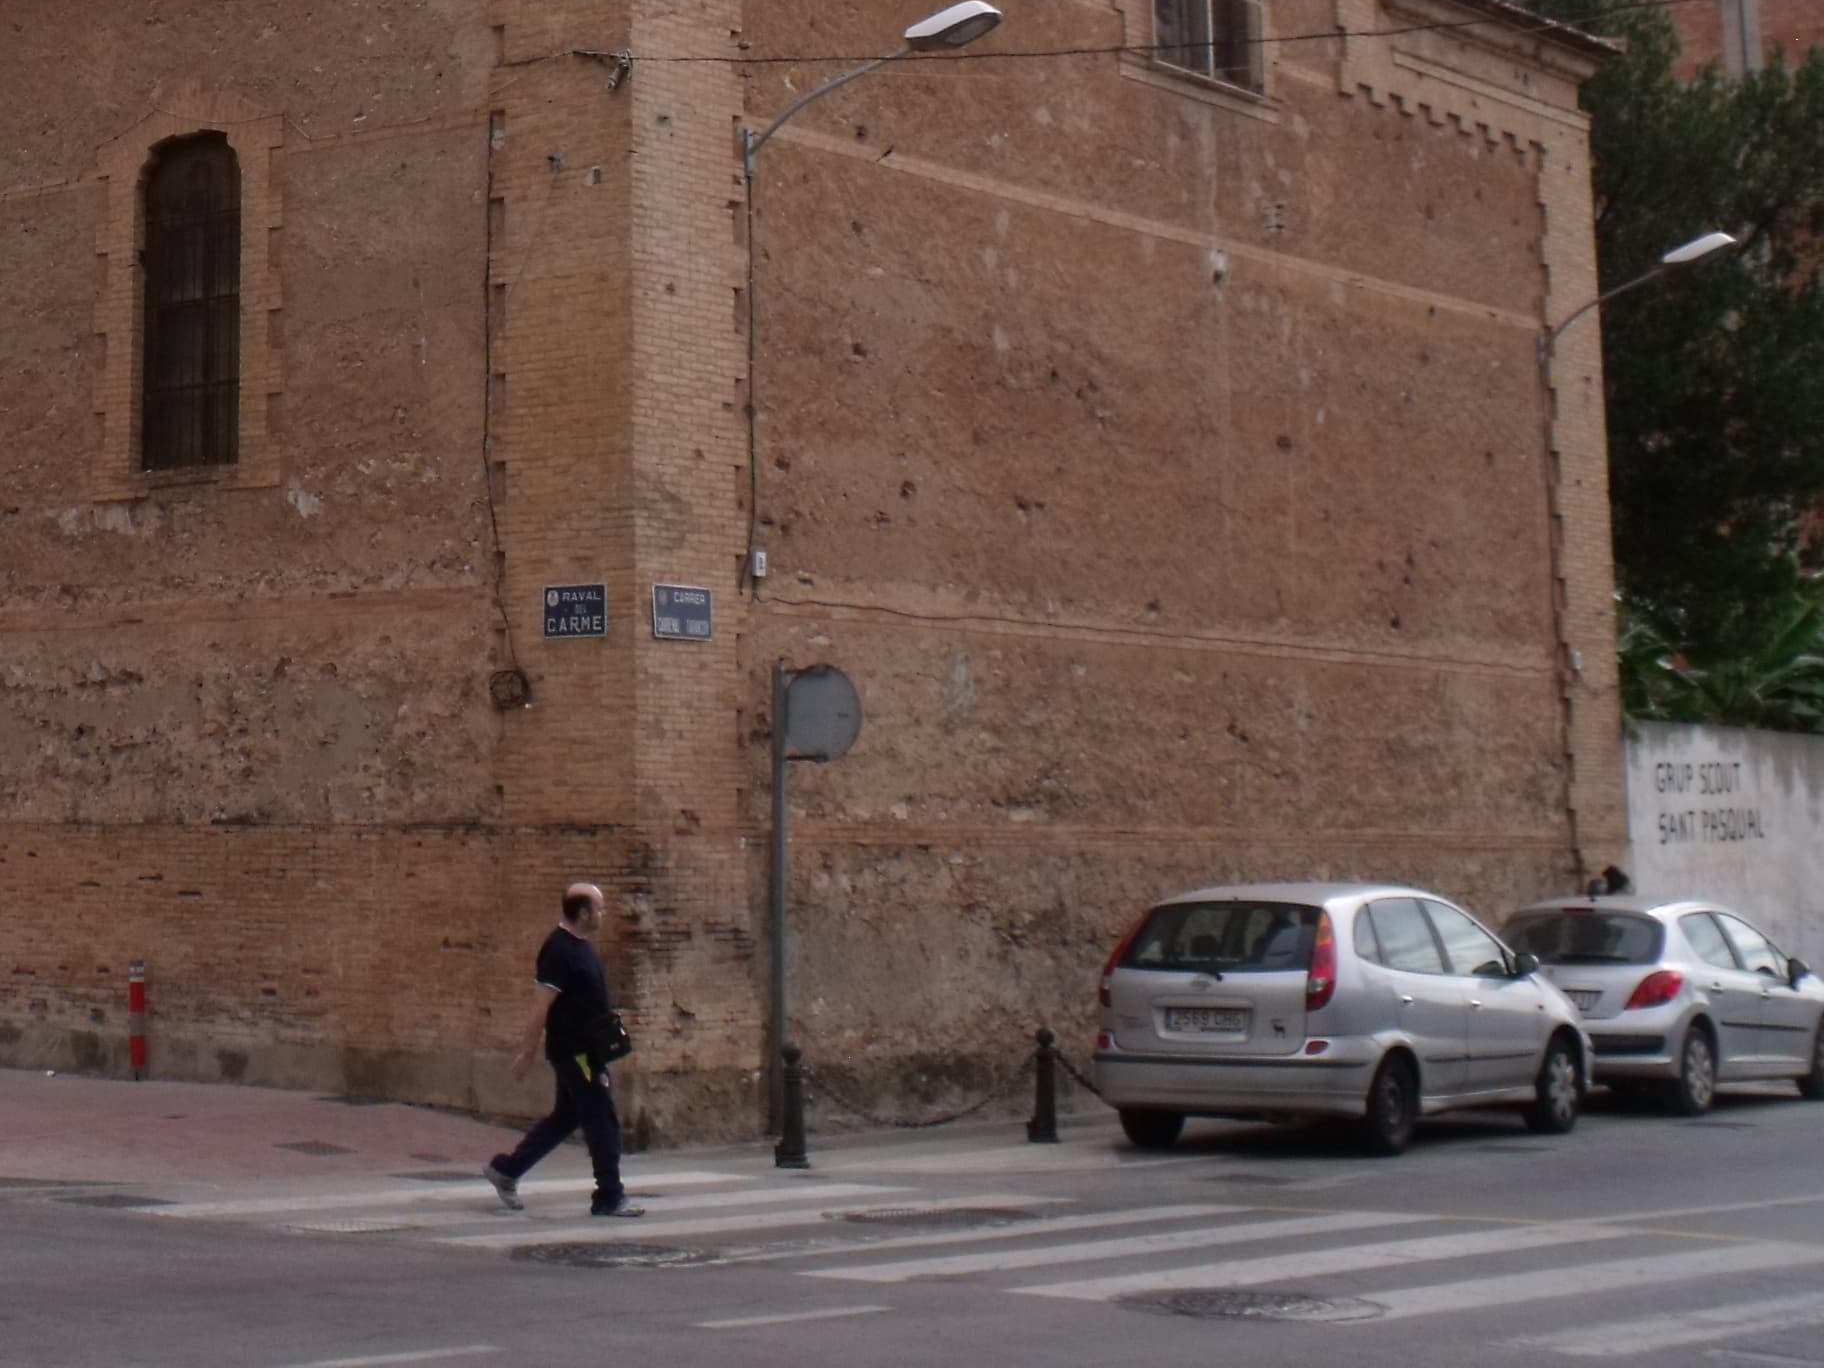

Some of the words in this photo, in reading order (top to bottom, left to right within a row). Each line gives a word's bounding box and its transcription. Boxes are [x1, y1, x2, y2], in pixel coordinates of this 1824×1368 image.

[562, 591, 601, 601] RAVAL
[673, 591, 705, 605] CARRER
[547, 615, 602, 633] CARME
[1656, 762, 1693, 793] GRUP
[1700, 761, 1741, 795] SCOUT
[1659, 809, 1695, 845] SANT
[1702, 807, 1765, 842] PASQUAL
